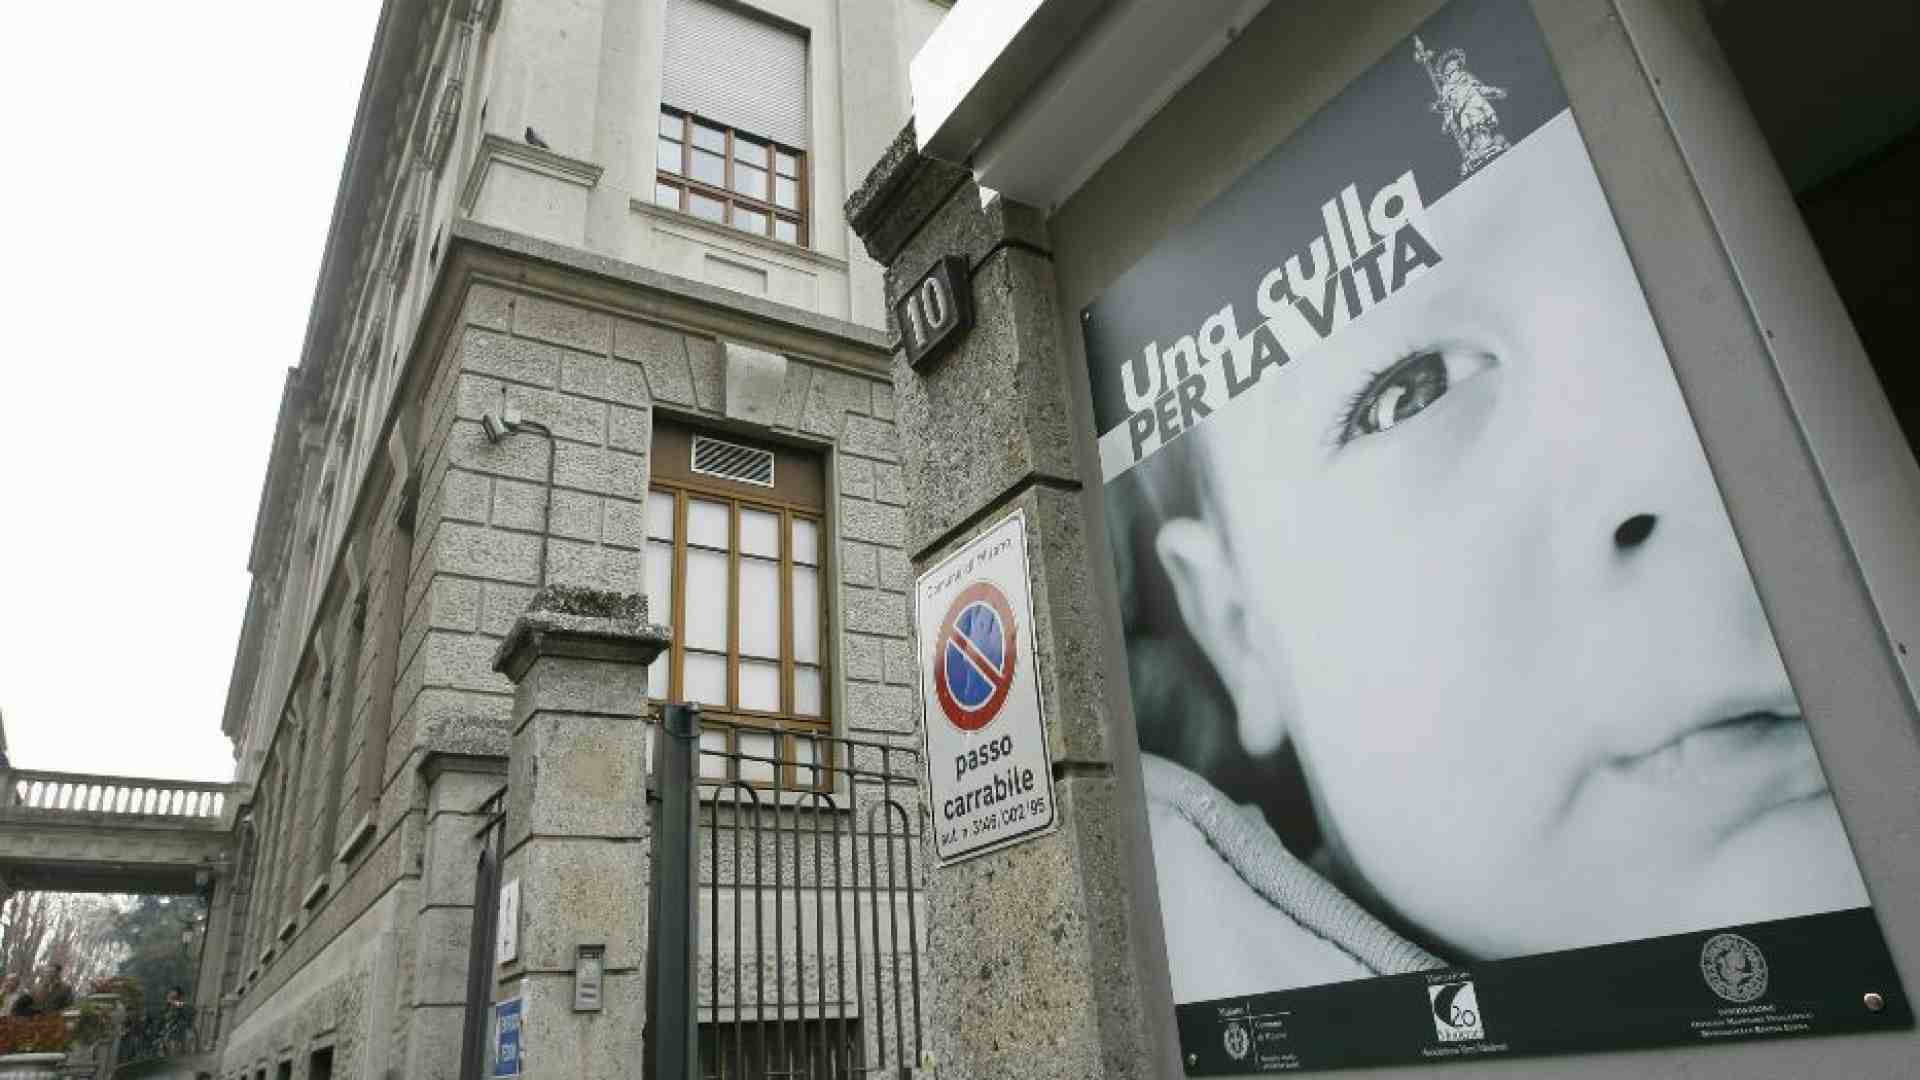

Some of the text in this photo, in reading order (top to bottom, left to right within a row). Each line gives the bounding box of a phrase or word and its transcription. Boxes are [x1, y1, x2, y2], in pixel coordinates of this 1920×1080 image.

[907, 277, 946, 346] 10
[1121, 169, 1424, 413] Una culla
[1128, 223, 1442, 462] PER LA VITA
[944, 766, 1034, 820] carrabile
[956, 736, 1013, 782] passo
